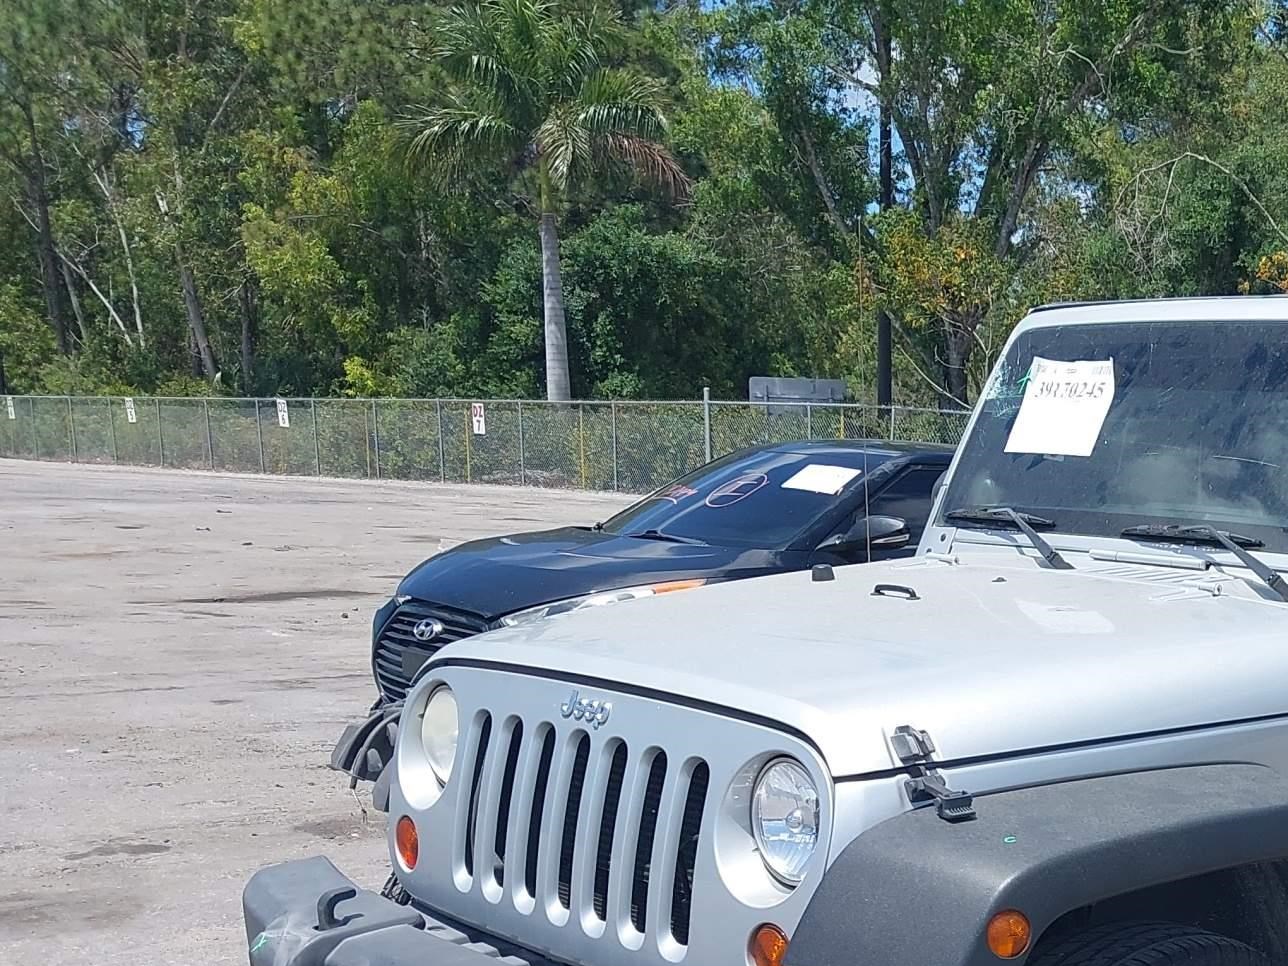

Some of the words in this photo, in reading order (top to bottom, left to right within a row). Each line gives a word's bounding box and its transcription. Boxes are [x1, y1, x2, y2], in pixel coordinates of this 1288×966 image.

[472, 405, 483, 418] DZ
[476, 419, 481, 432] 7
[561, 689, 612, 730] Jeep
